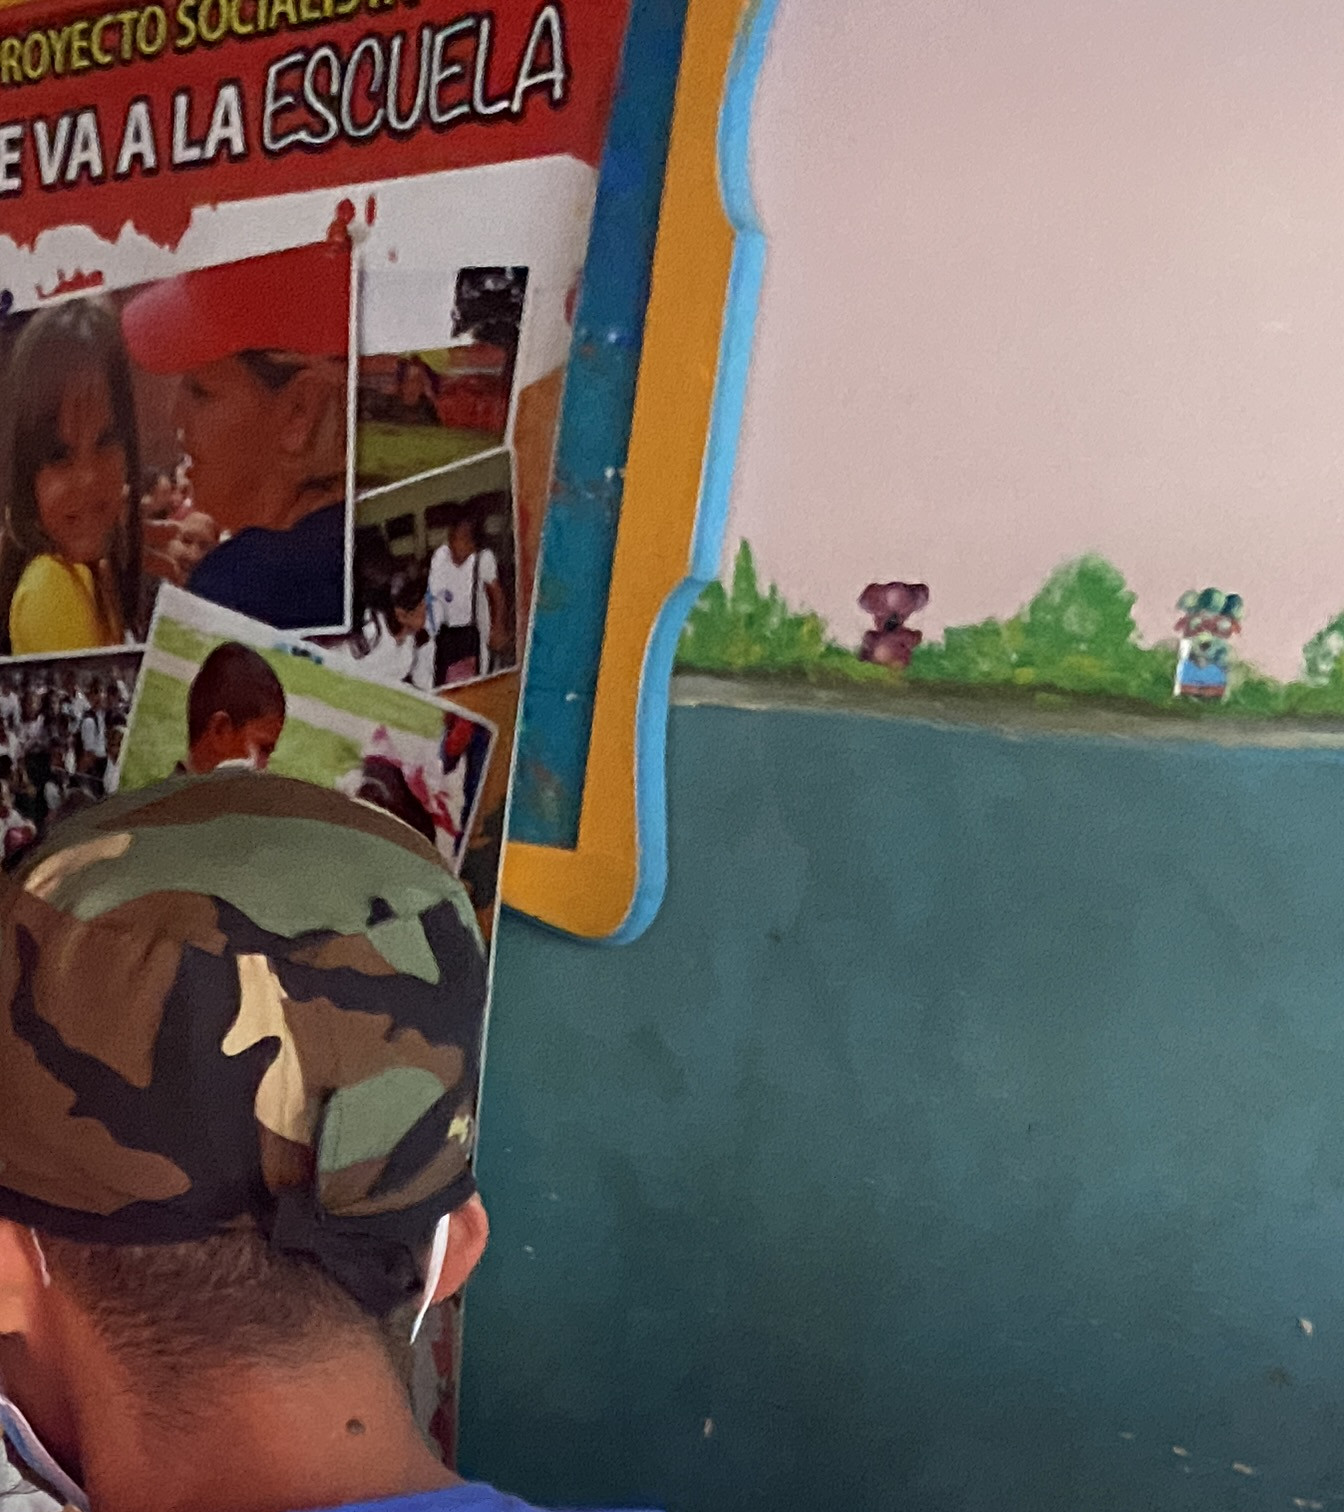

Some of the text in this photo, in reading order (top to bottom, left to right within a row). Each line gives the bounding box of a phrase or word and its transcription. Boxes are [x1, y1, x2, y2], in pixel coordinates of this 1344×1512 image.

[175, 0, 402, 48] SOCIA
[34, 111, 103, 185] VA
[116, 102, 156, 174] A
[172, 85, 247, 165] LA
[263, 4, 568, 151] ESCUELA
